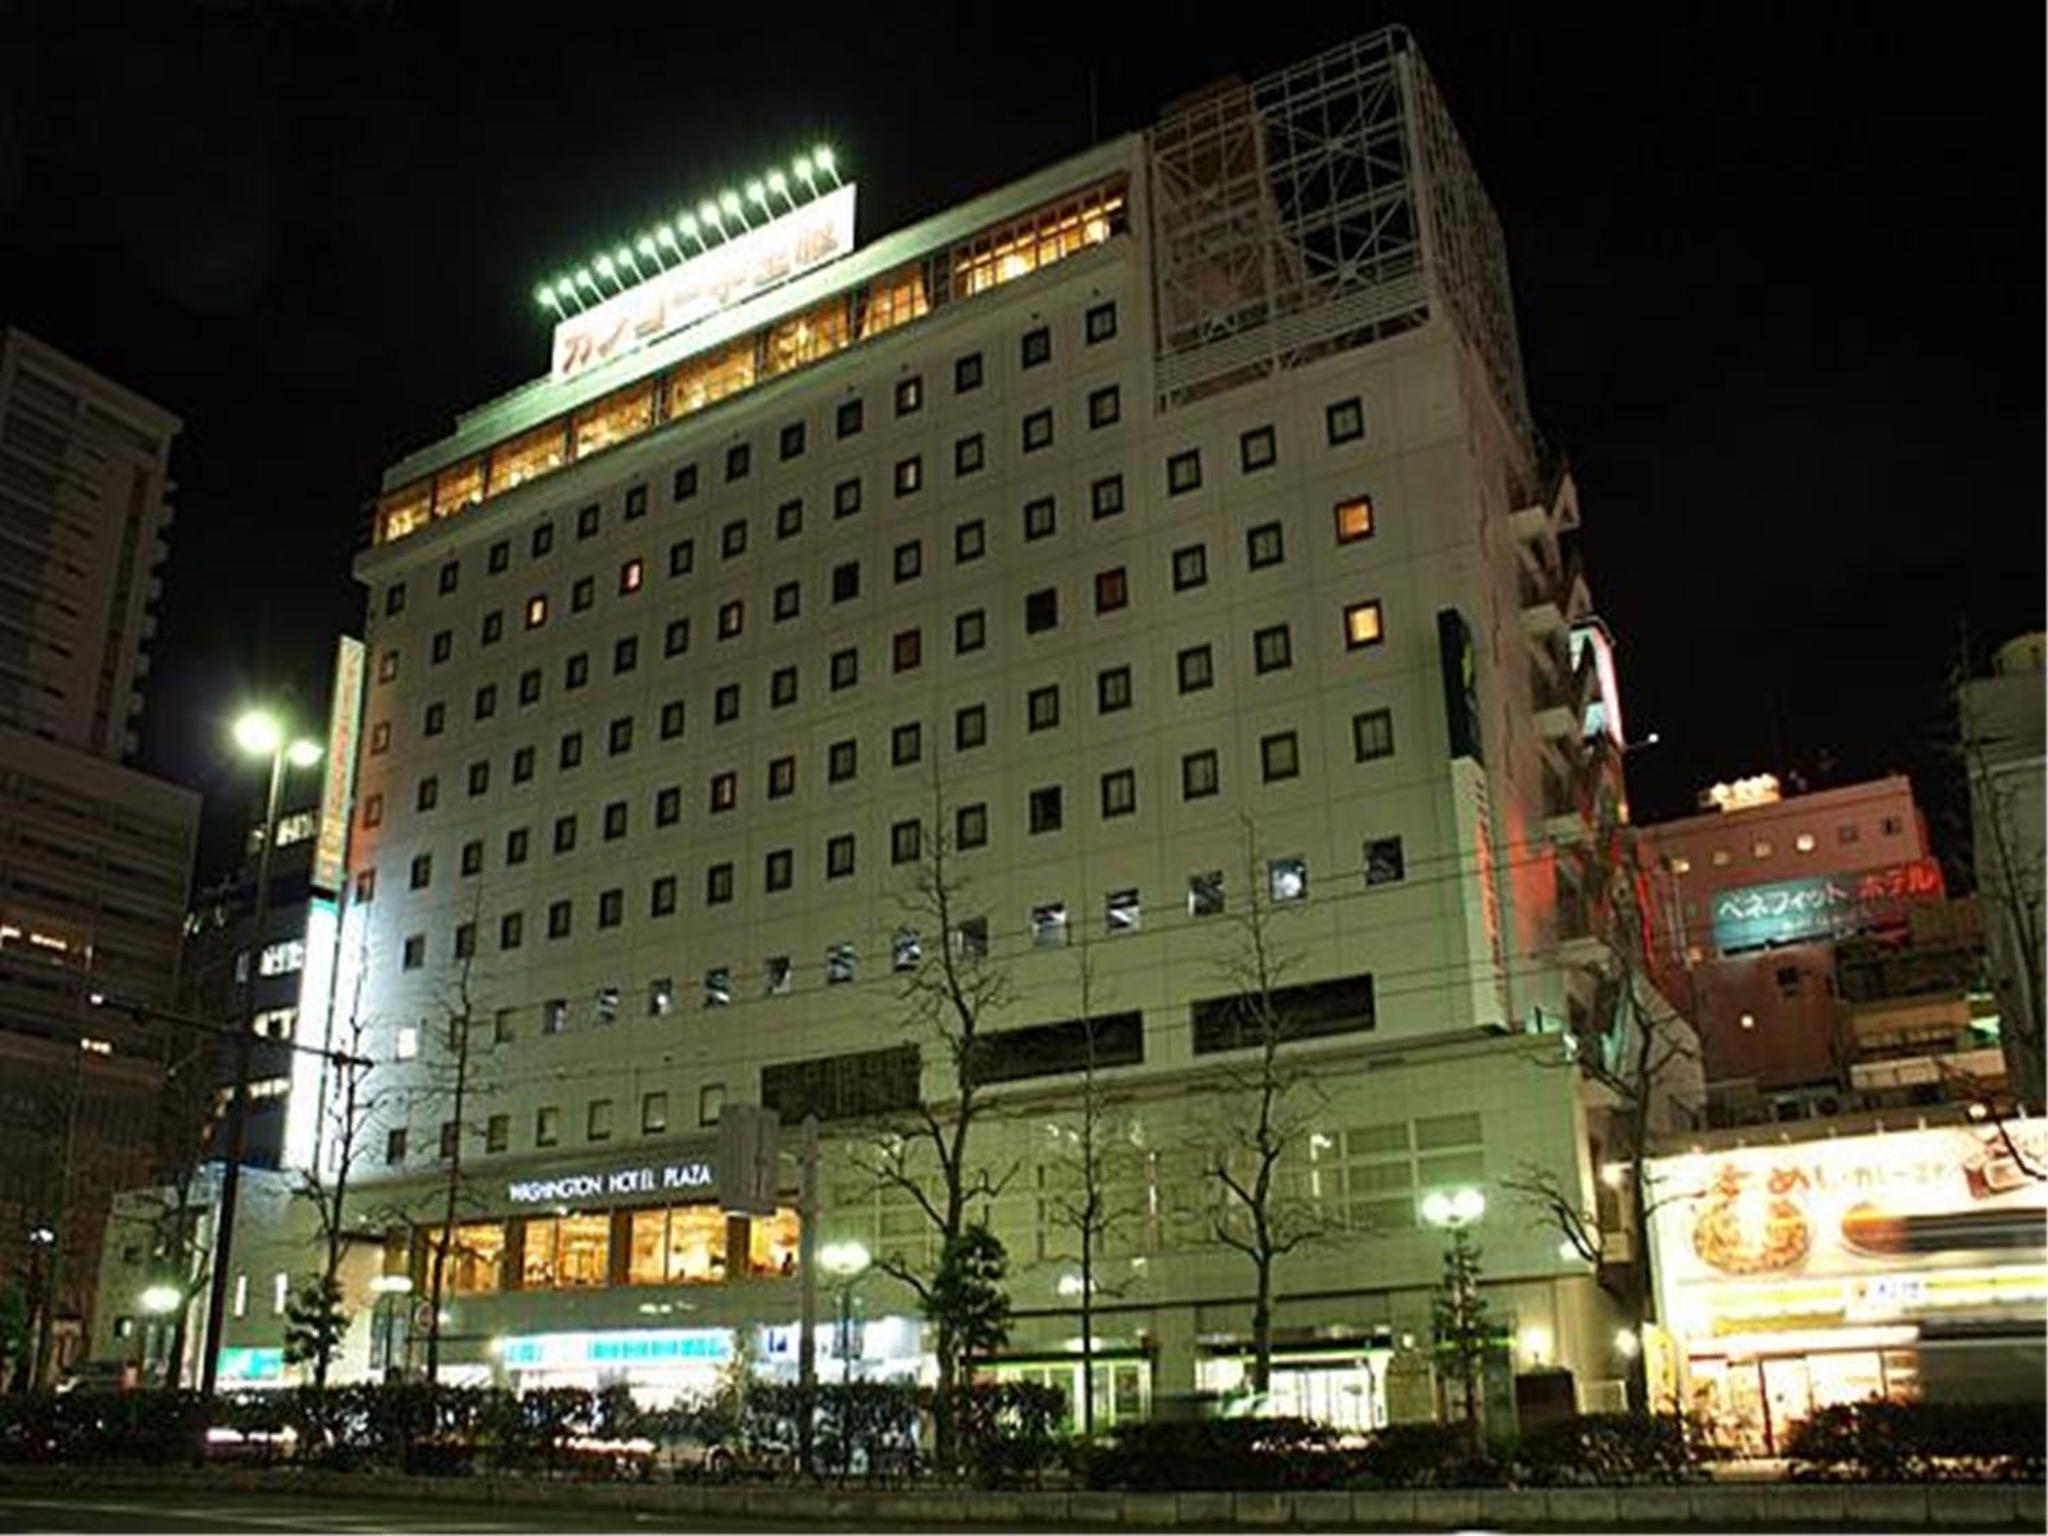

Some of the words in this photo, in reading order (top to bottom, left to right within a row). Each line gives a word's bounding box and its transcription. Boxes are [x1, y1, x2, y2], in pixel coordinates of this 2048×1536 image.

[1858, 863, 1937, 898] ホテル
[508, 1176, 602, 1202] WASHINGTON
[608, 1169, 655, 1193] HOTEL
[663, 1164, 712, 1187] PLAZA
